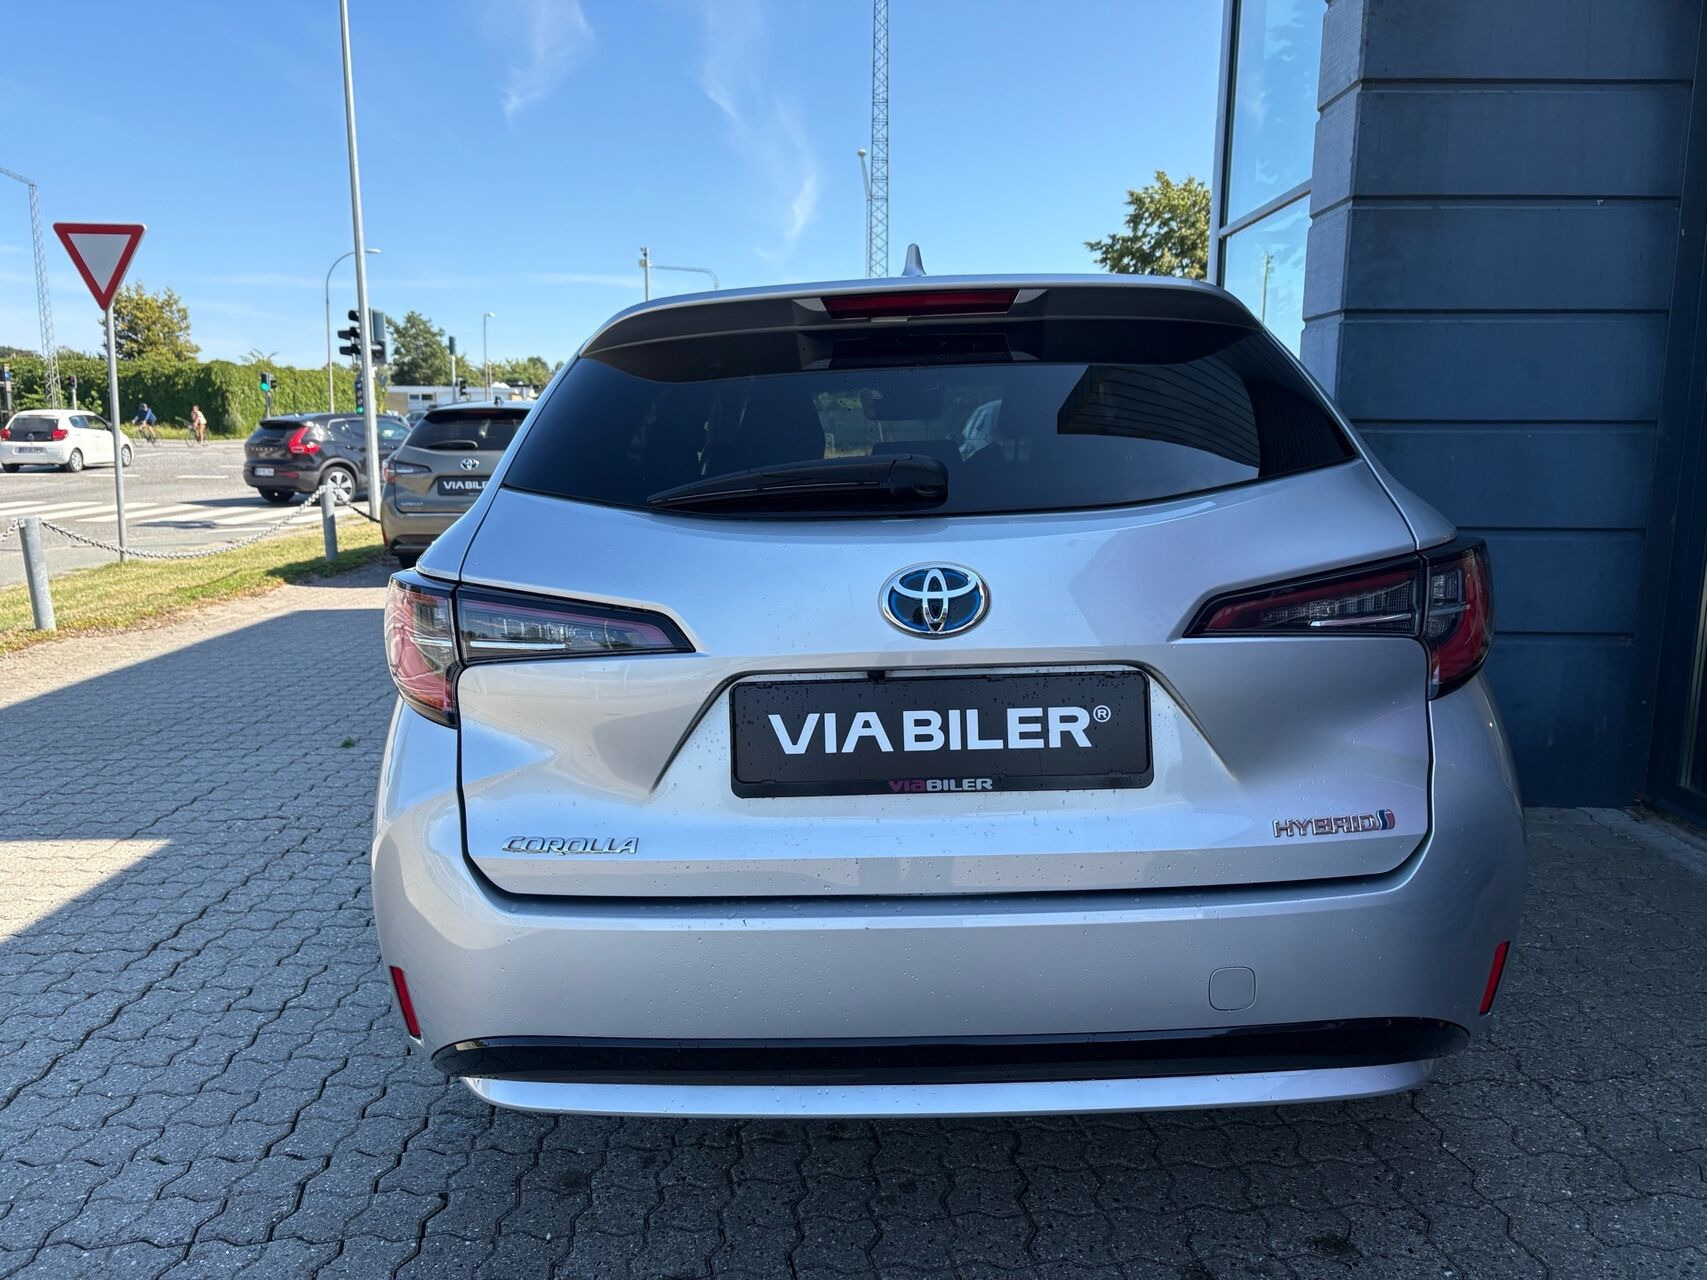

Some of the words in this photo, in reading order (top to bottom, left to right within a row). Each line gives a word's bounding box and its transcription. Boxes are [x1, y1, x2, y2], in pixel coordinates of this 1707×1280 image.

[443, 480, 464, 490] VIA
[768, 711, 894, 755] VIA
[1272, 814, 1379, 838] HYBRID
[502, 836, 639, 855] COROLLA
